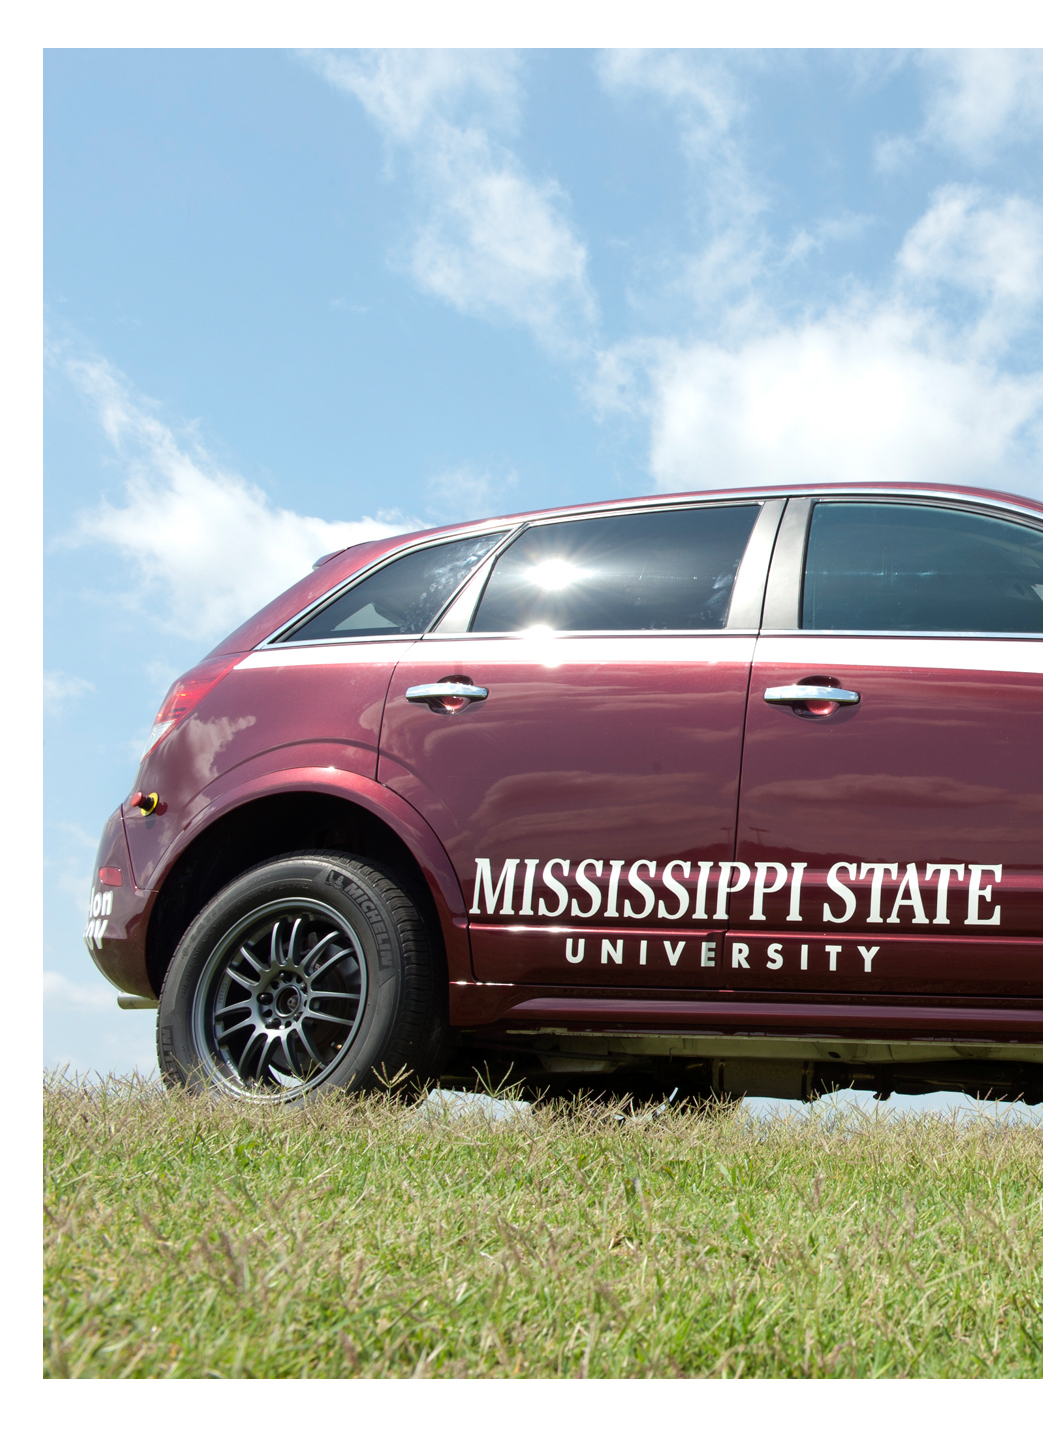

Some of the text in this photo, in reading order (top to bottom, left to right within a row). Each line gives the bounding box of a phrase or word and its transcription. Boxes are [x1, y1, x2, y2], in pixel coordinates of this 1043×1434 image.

[343, 881, 395, 967] MICHELIN
[468, 857, 1003, 926] MISSISSIPPI STATE
[565, 938, 881, 973] UNIVERSITY
